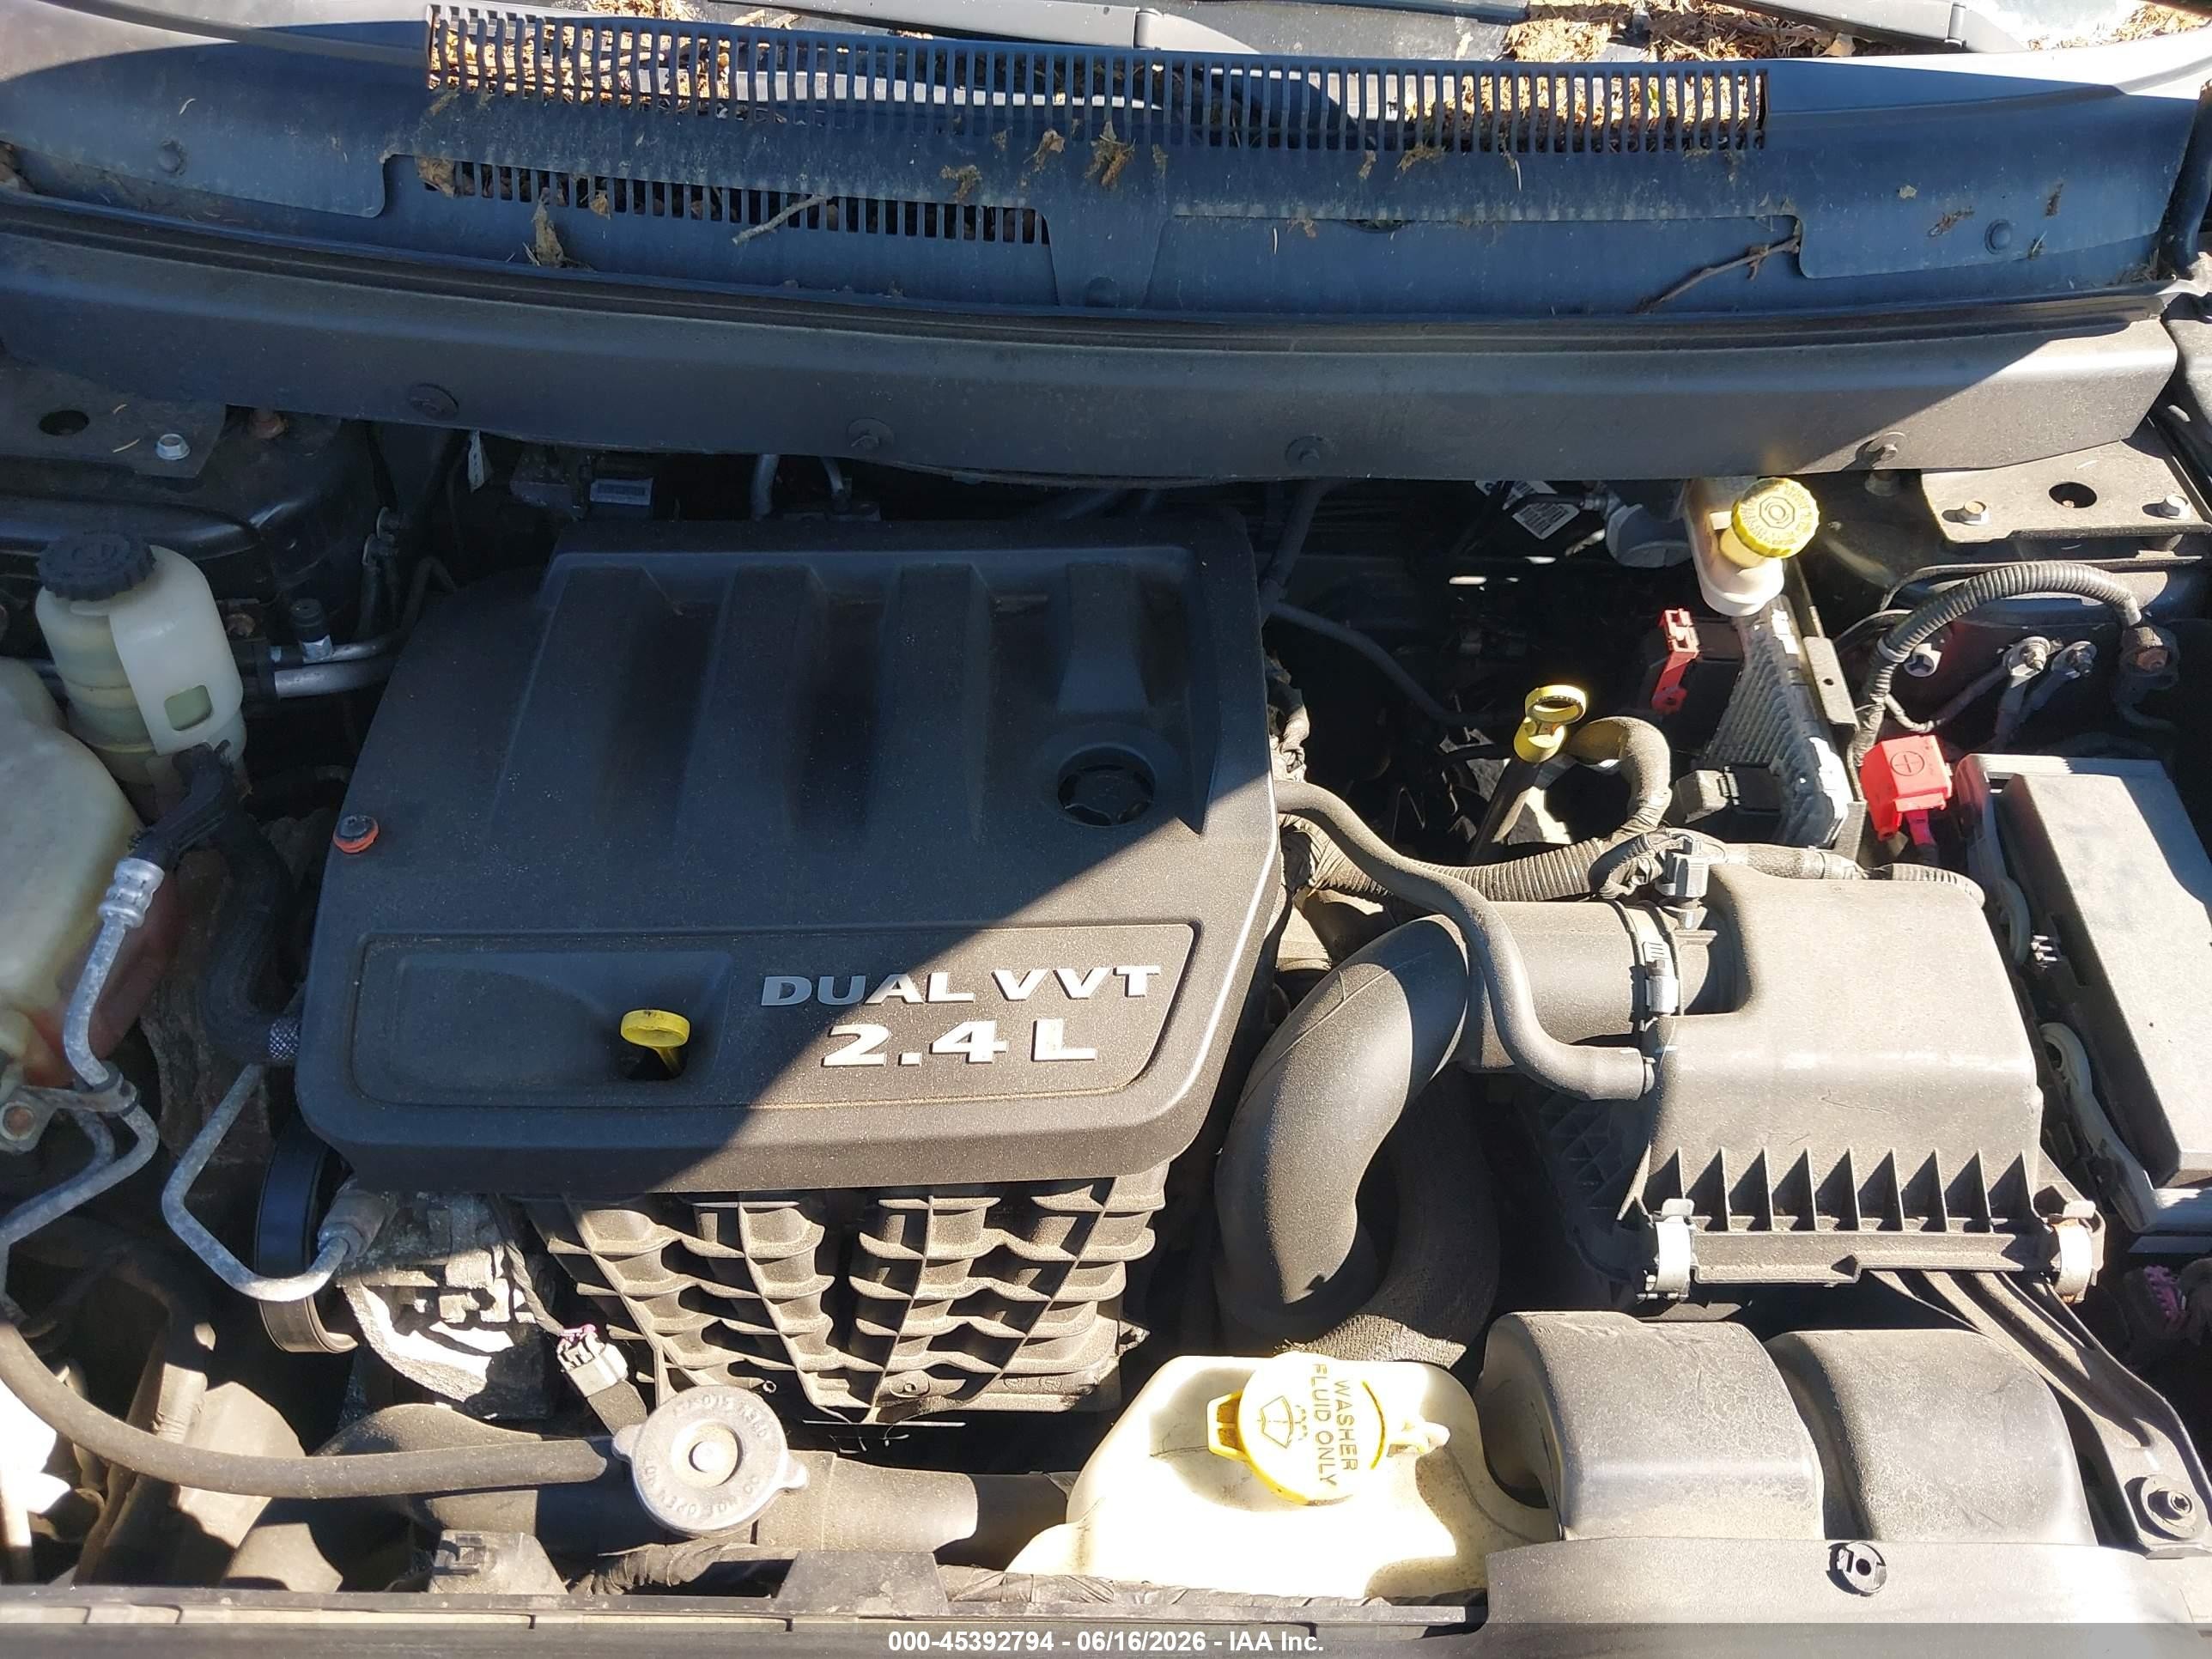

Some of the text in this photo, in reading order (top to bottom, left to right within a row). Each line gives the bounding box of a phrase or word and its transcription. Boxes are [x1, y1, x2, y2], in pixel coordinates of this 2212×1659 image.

[761, 965, 1162, 1007] DUAL VVT
[820, 1018, 1097, 1067] 2.4 L
[1310, 1363, 1338, 1486] FLUID ONLY
[1334, 1379, 1359, 1471] WASHER
